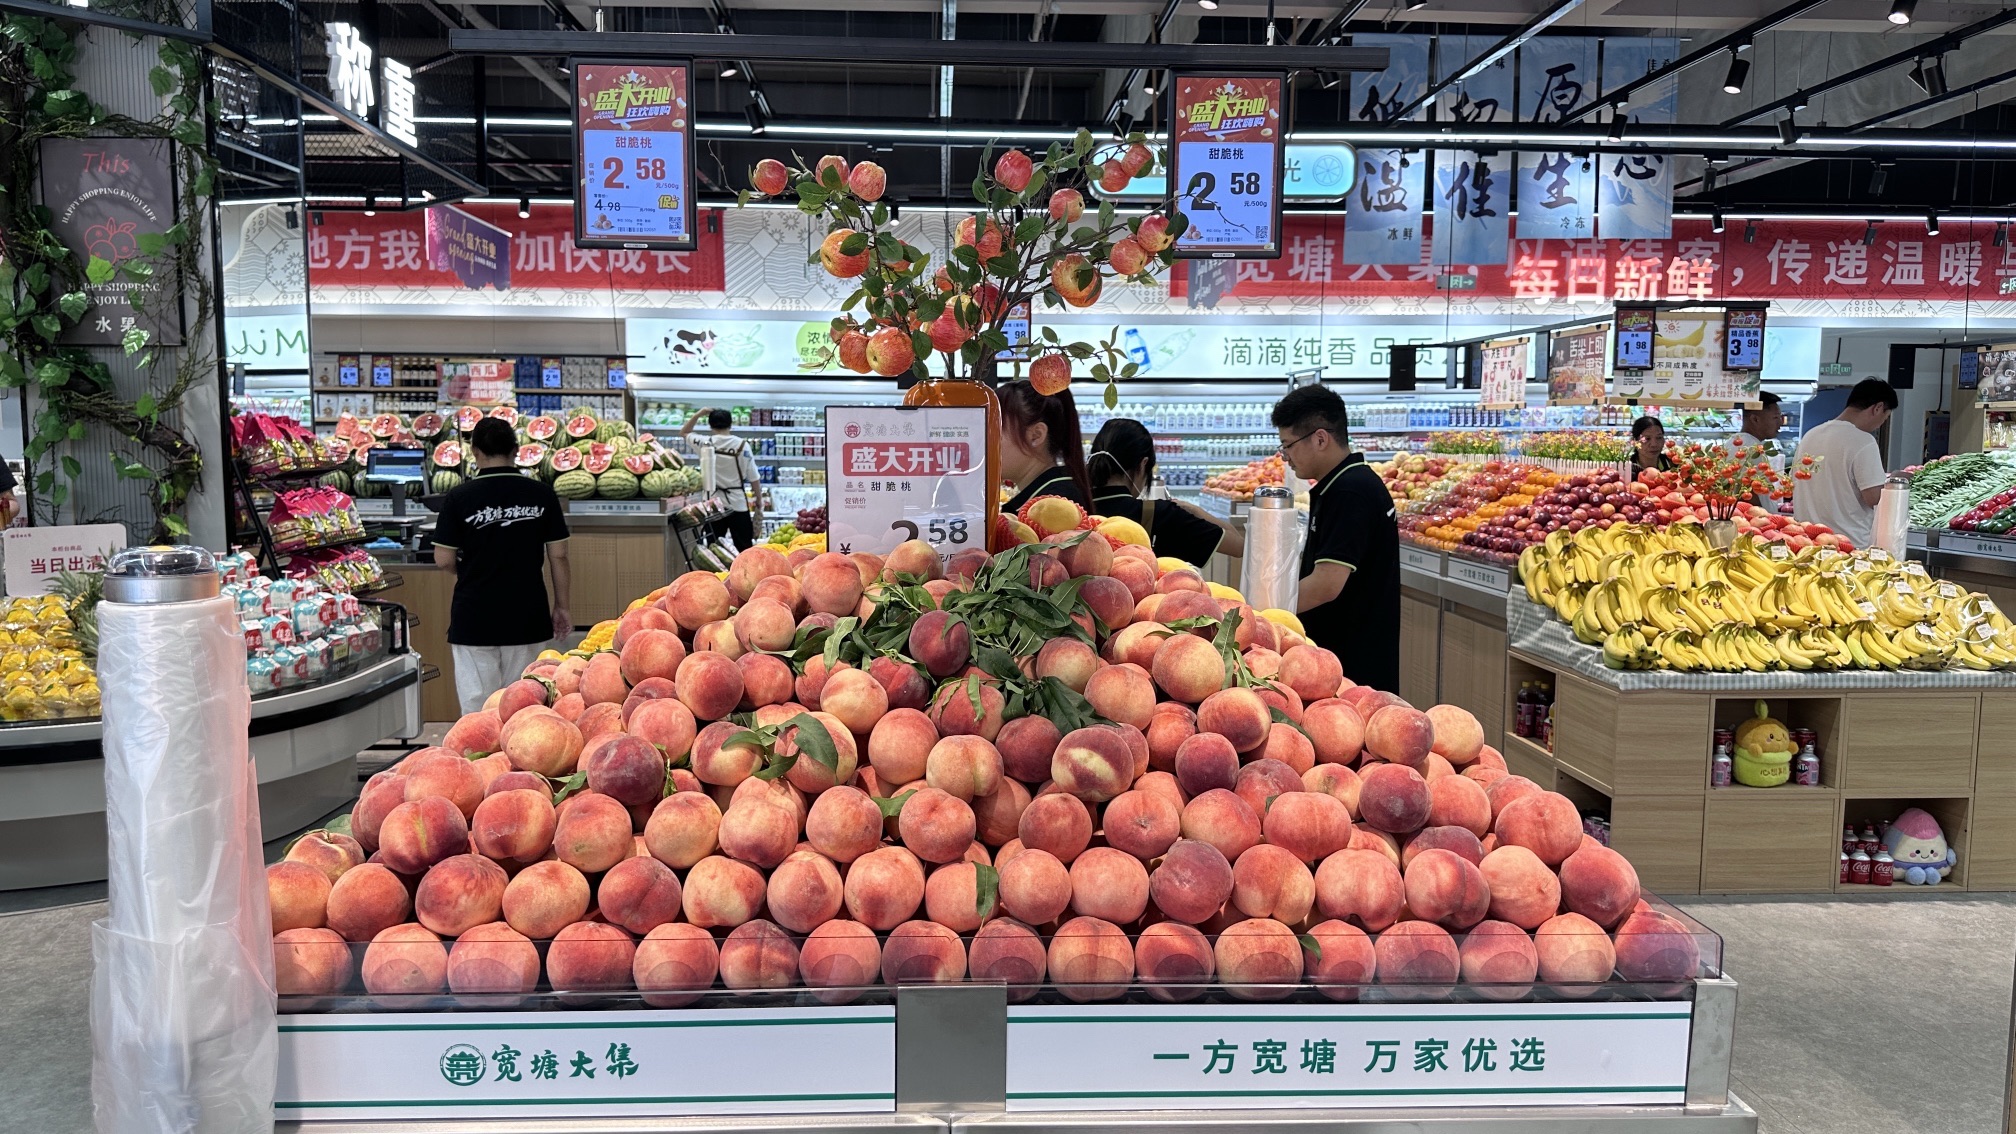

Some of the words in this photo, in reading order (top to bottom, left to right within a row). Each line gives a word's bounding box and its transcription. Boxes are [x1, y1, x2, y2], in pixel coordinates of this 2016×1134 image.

[334, 22, 418, 149] 称重
[594, 84, 671, 117] 盛大开业
[1188, 94, 1266, 129] 盛大开业
[615, 136, 652, 149] 甜脆桃
[82, 151, 130, 174] This
[1209, 148, 1244, 160] 甜脆桃
[636, 158, 666, 180] 58
[1230, 172, 1260, 195] 58
[62, 199, 80, 224] HAPPY
[79, 187, 119, 203] SHOPPING
[120, 189, 144, 208] ENJOY
[142, 204, 157, 223] LIFE
[594, 199, 621, 212] 4.98
[1387, 228, 1413, 241] 冰鲜
[1560, 217, 1586, 230] 冷冻
[1510, 255, 1714, 304] 每日新鲜
[95, 316, 136, 333] 水果
[1731, 330, 1759, 338] 精品香蕉
[1223, 337, 1357, 366] 滴滴纯香
[1636, 341, 1646, 349] 98
[1747, 339, 1759, 348] 98
[850, 446, 962, 473] 盛大开业
[871, 481, 911, 492] 甜脆桃
[844, 497, 866, 505] 促销价
[929, 518, 968, 545] 58
[30, 555, 103, 574] 当日出清
[492, 1042, 639, 1082] 宽塘大集
[1152, 1038, 1338, 1075] 一方宽塘
[1364, 1036, 1547, 1074] 万家优选
